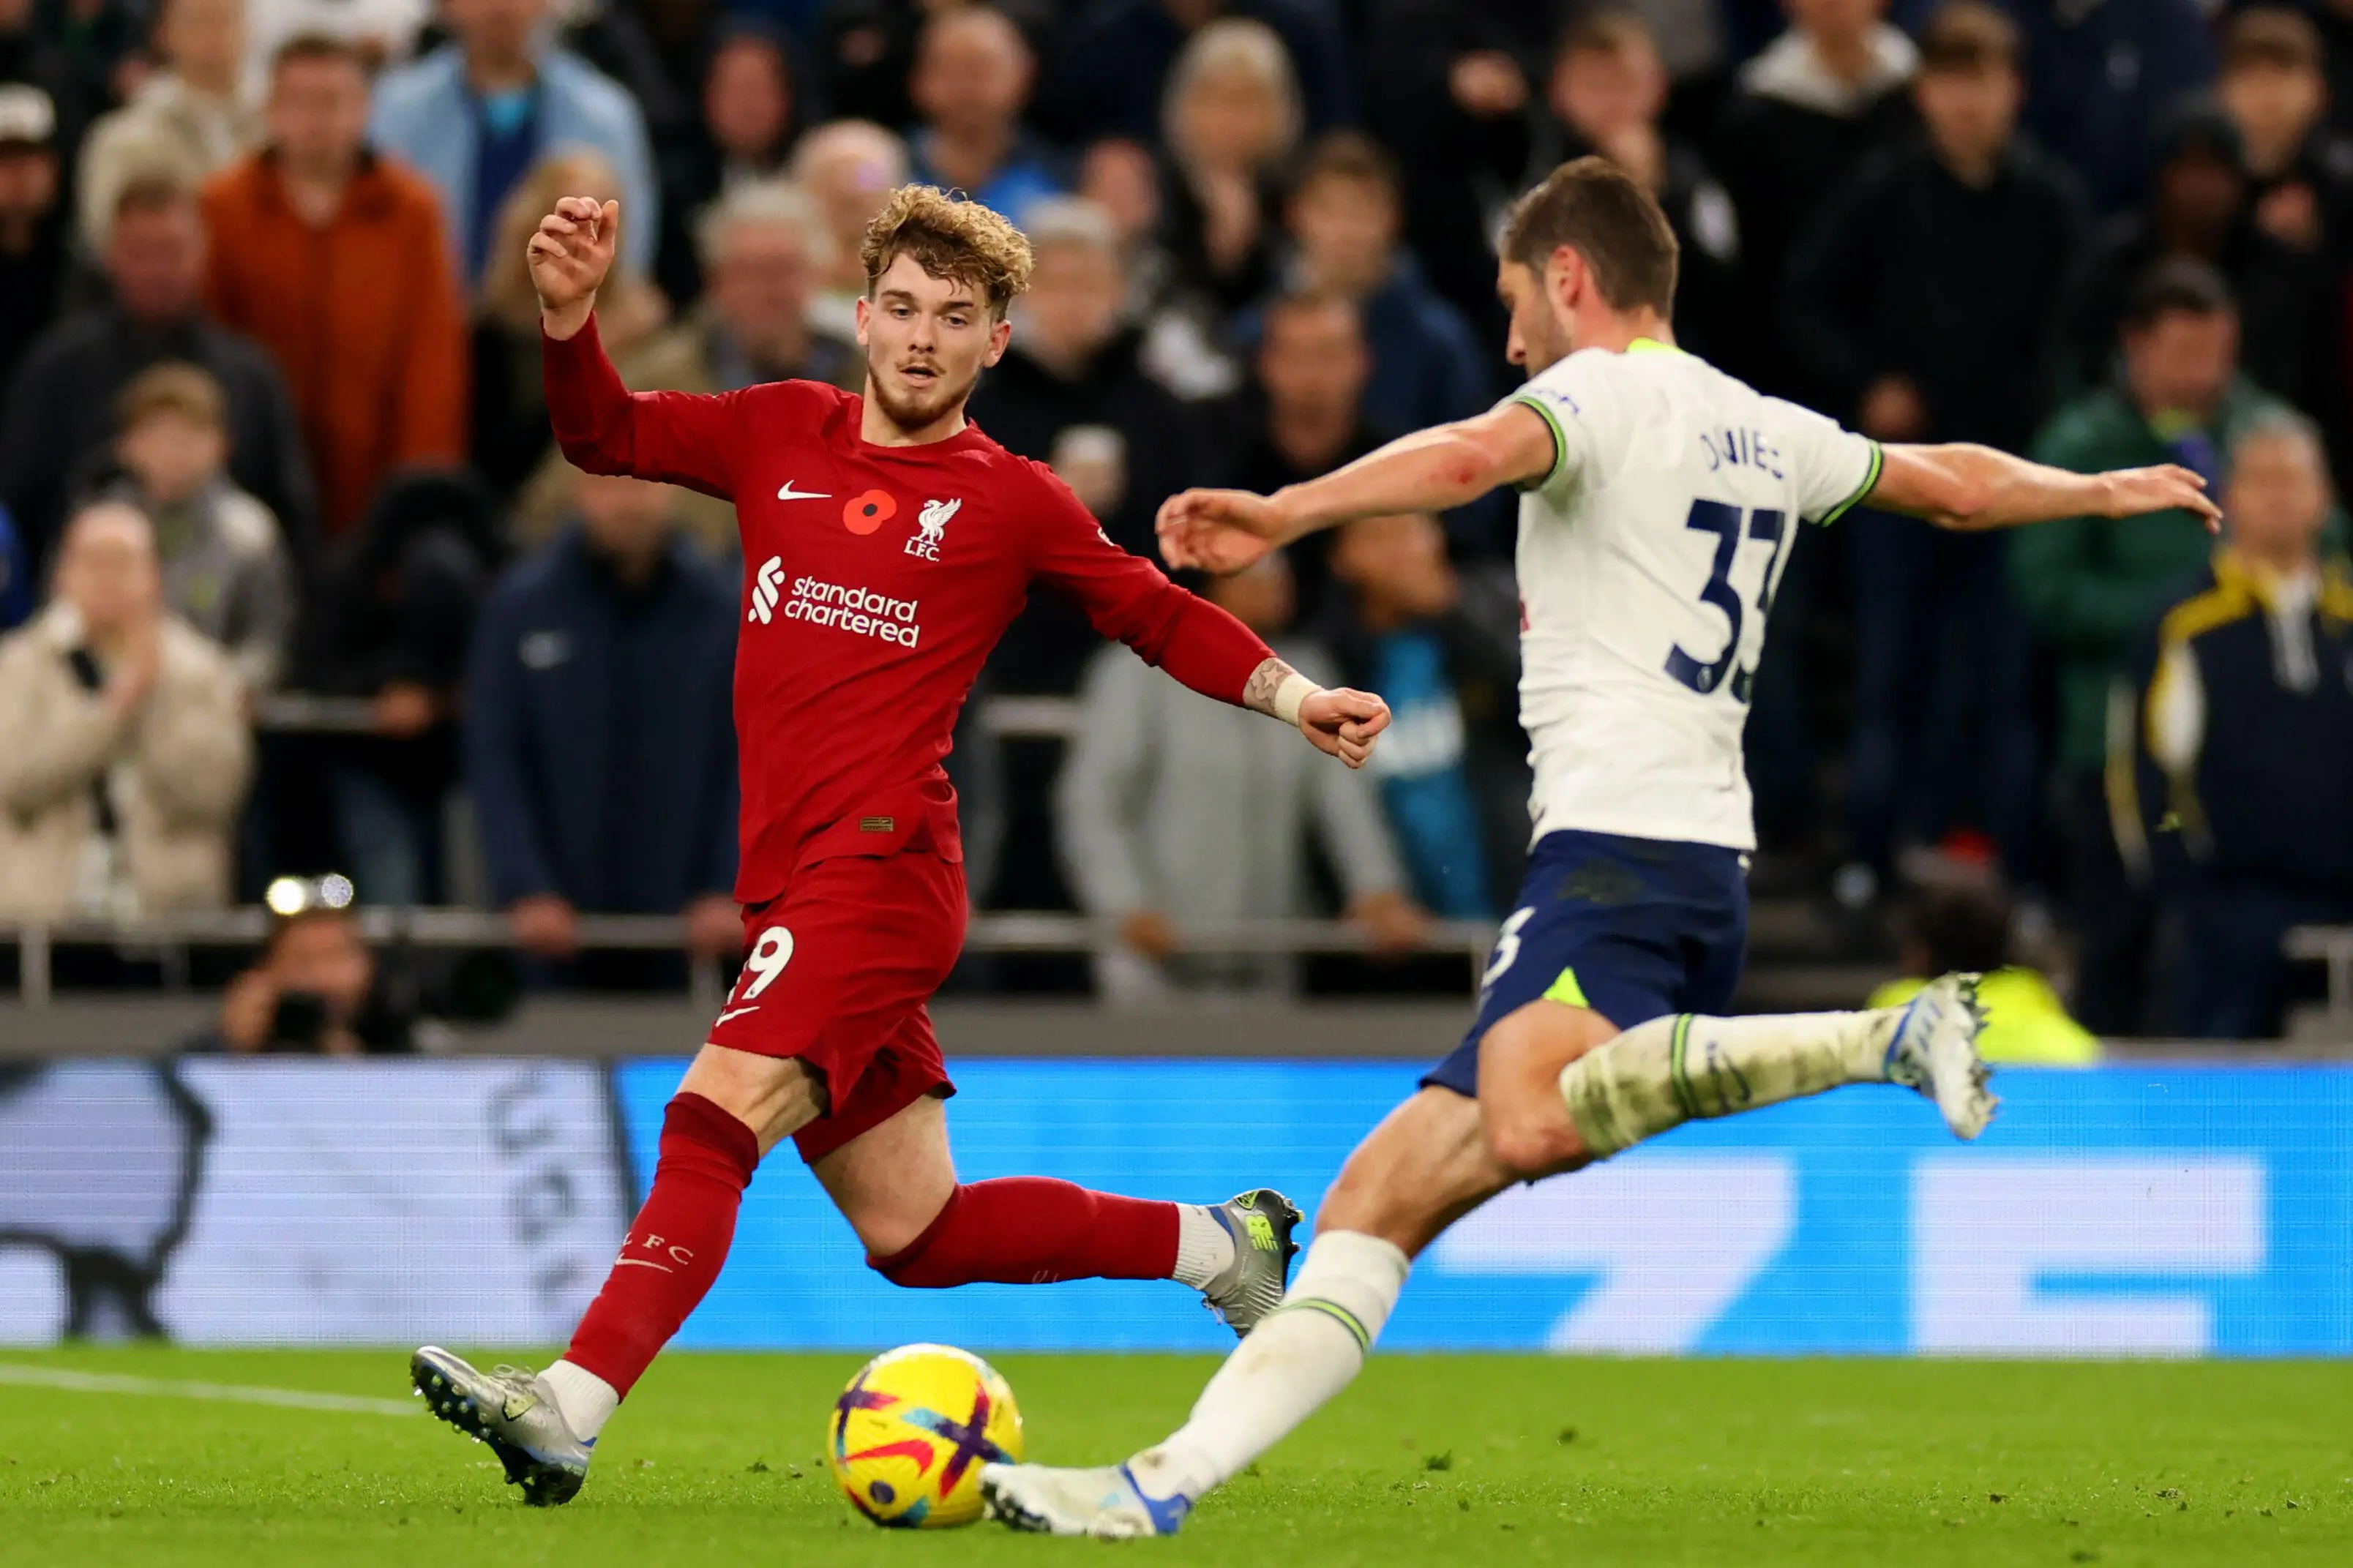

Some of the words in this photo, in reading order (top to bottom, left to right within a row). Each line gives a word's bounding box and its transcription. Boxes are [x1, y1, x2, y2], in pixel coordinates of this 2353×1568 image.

[1699, 427, 1784, 480] DVIE
[784, 599, 920, 648] chartered
[791, 576, 918, 623] standard
[727, 926, 794, 1006] 9
